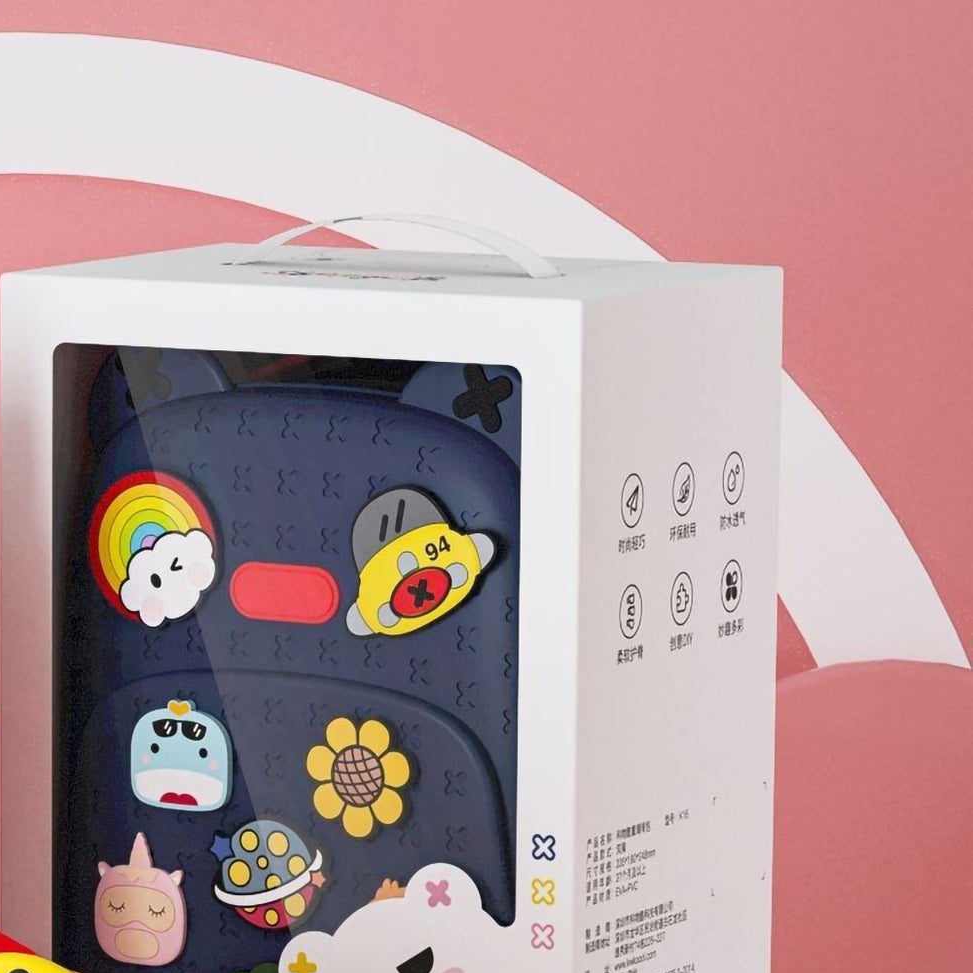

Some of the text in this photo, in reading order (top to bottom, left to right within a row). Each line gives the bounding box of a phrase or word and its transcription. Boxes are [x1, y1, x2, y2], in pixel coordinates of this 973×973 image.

[669, 522, 696, 542] 环保耐用
[424, 535, 451, 561] 94
[618, 534, 646, 554] 时尚轻巧
